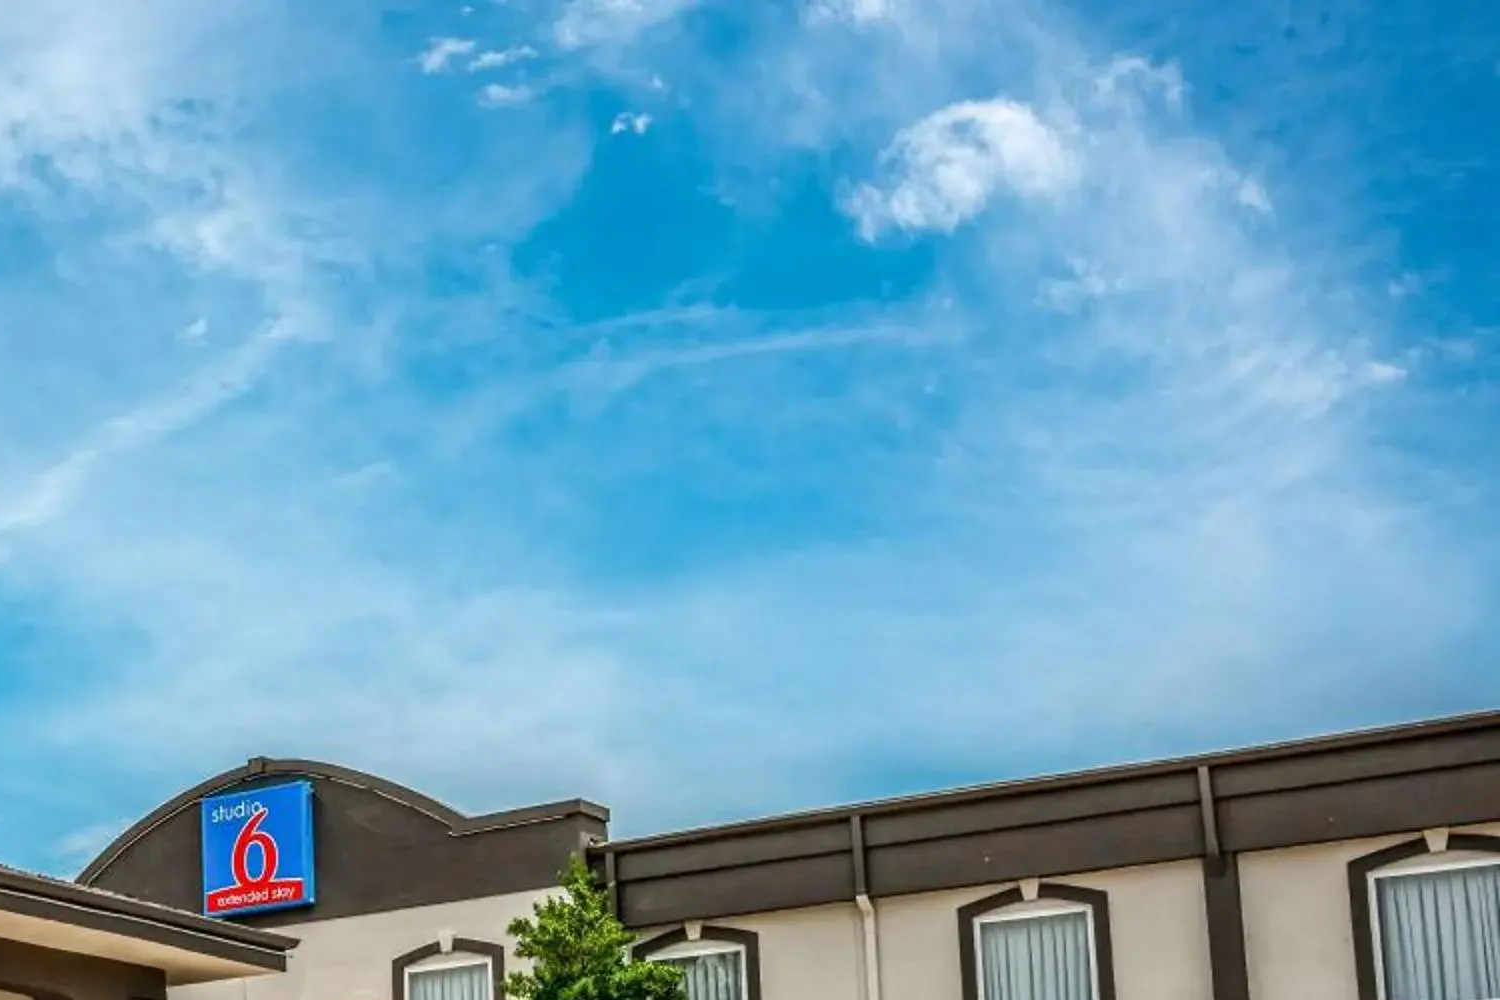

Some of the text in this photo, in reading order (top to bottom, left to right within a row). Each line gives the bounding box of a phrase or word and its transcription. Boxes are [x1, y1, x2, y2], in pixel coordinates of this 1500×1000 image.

[211, 800, 263, 823] studio
[231, 807, 279, 885] 6
[217, 886, 295, 907] extended stay
